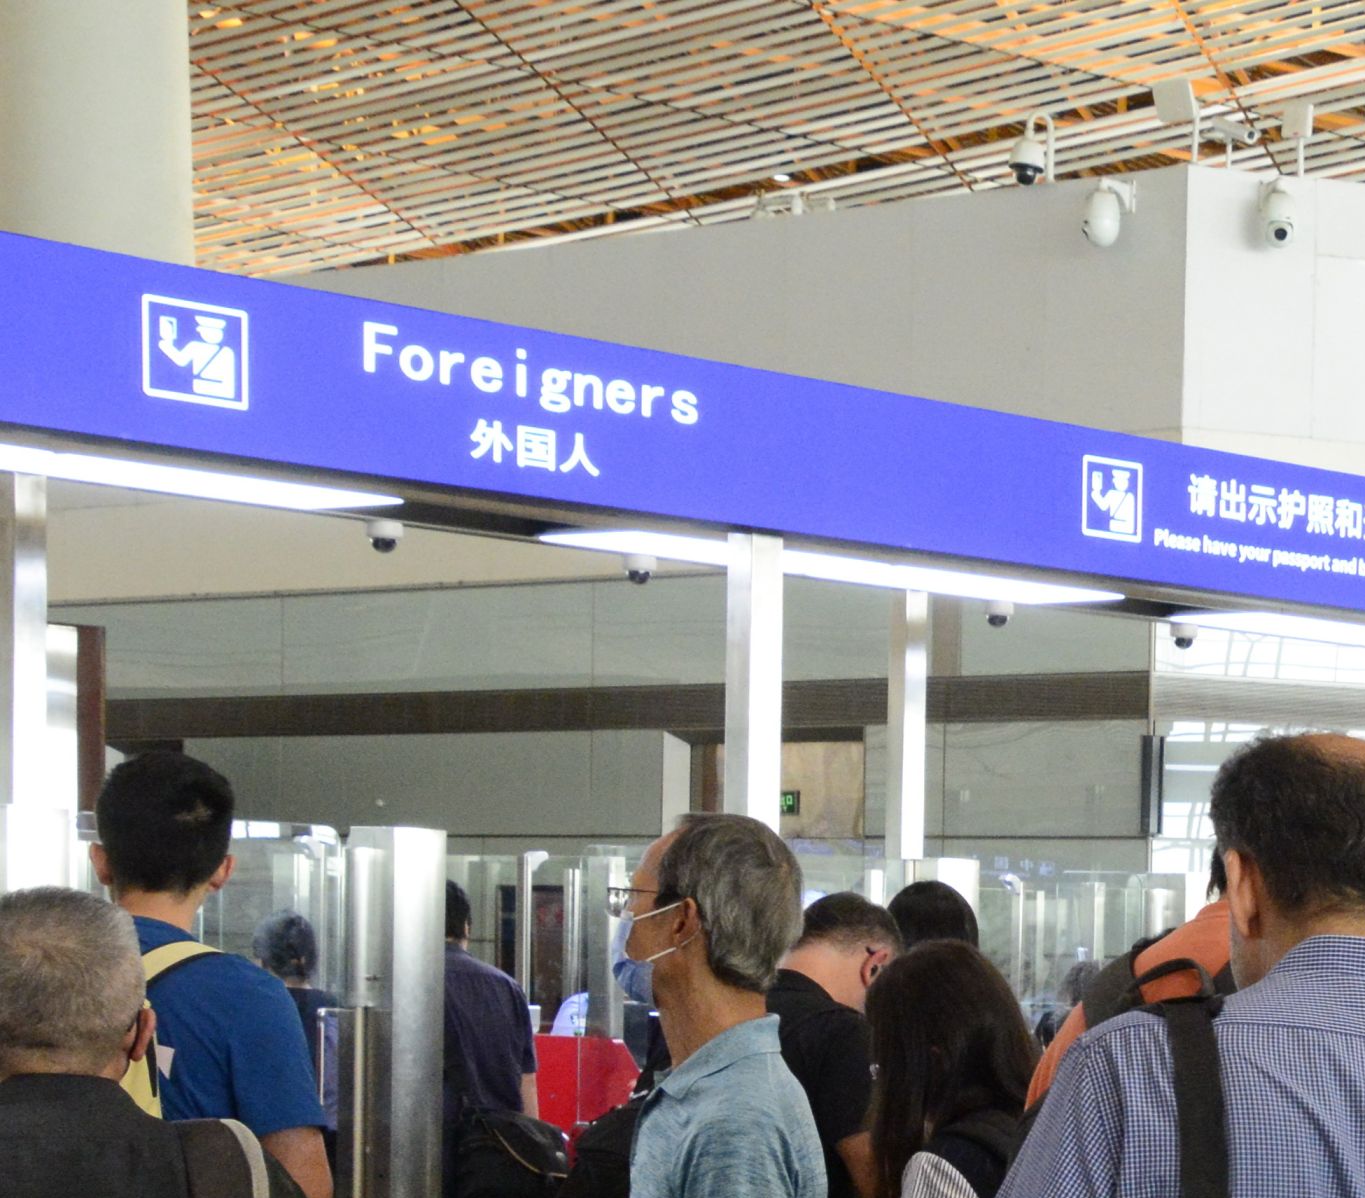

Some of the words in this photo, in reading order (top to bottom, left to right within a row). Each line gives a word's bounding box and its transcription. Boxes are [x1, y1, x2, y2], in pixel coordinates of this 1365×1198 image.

[363, 321, 699, 425] Foreigners
[470, 419, 600, 477] 外国人
[1154, 528, 1201, 553] Please
[1203, 535, 1238, 558] have
[1239, 544, 1271, 563] your
[1272, 549, 1331, 572] passport
[1332, 558, 1357, 575] and
